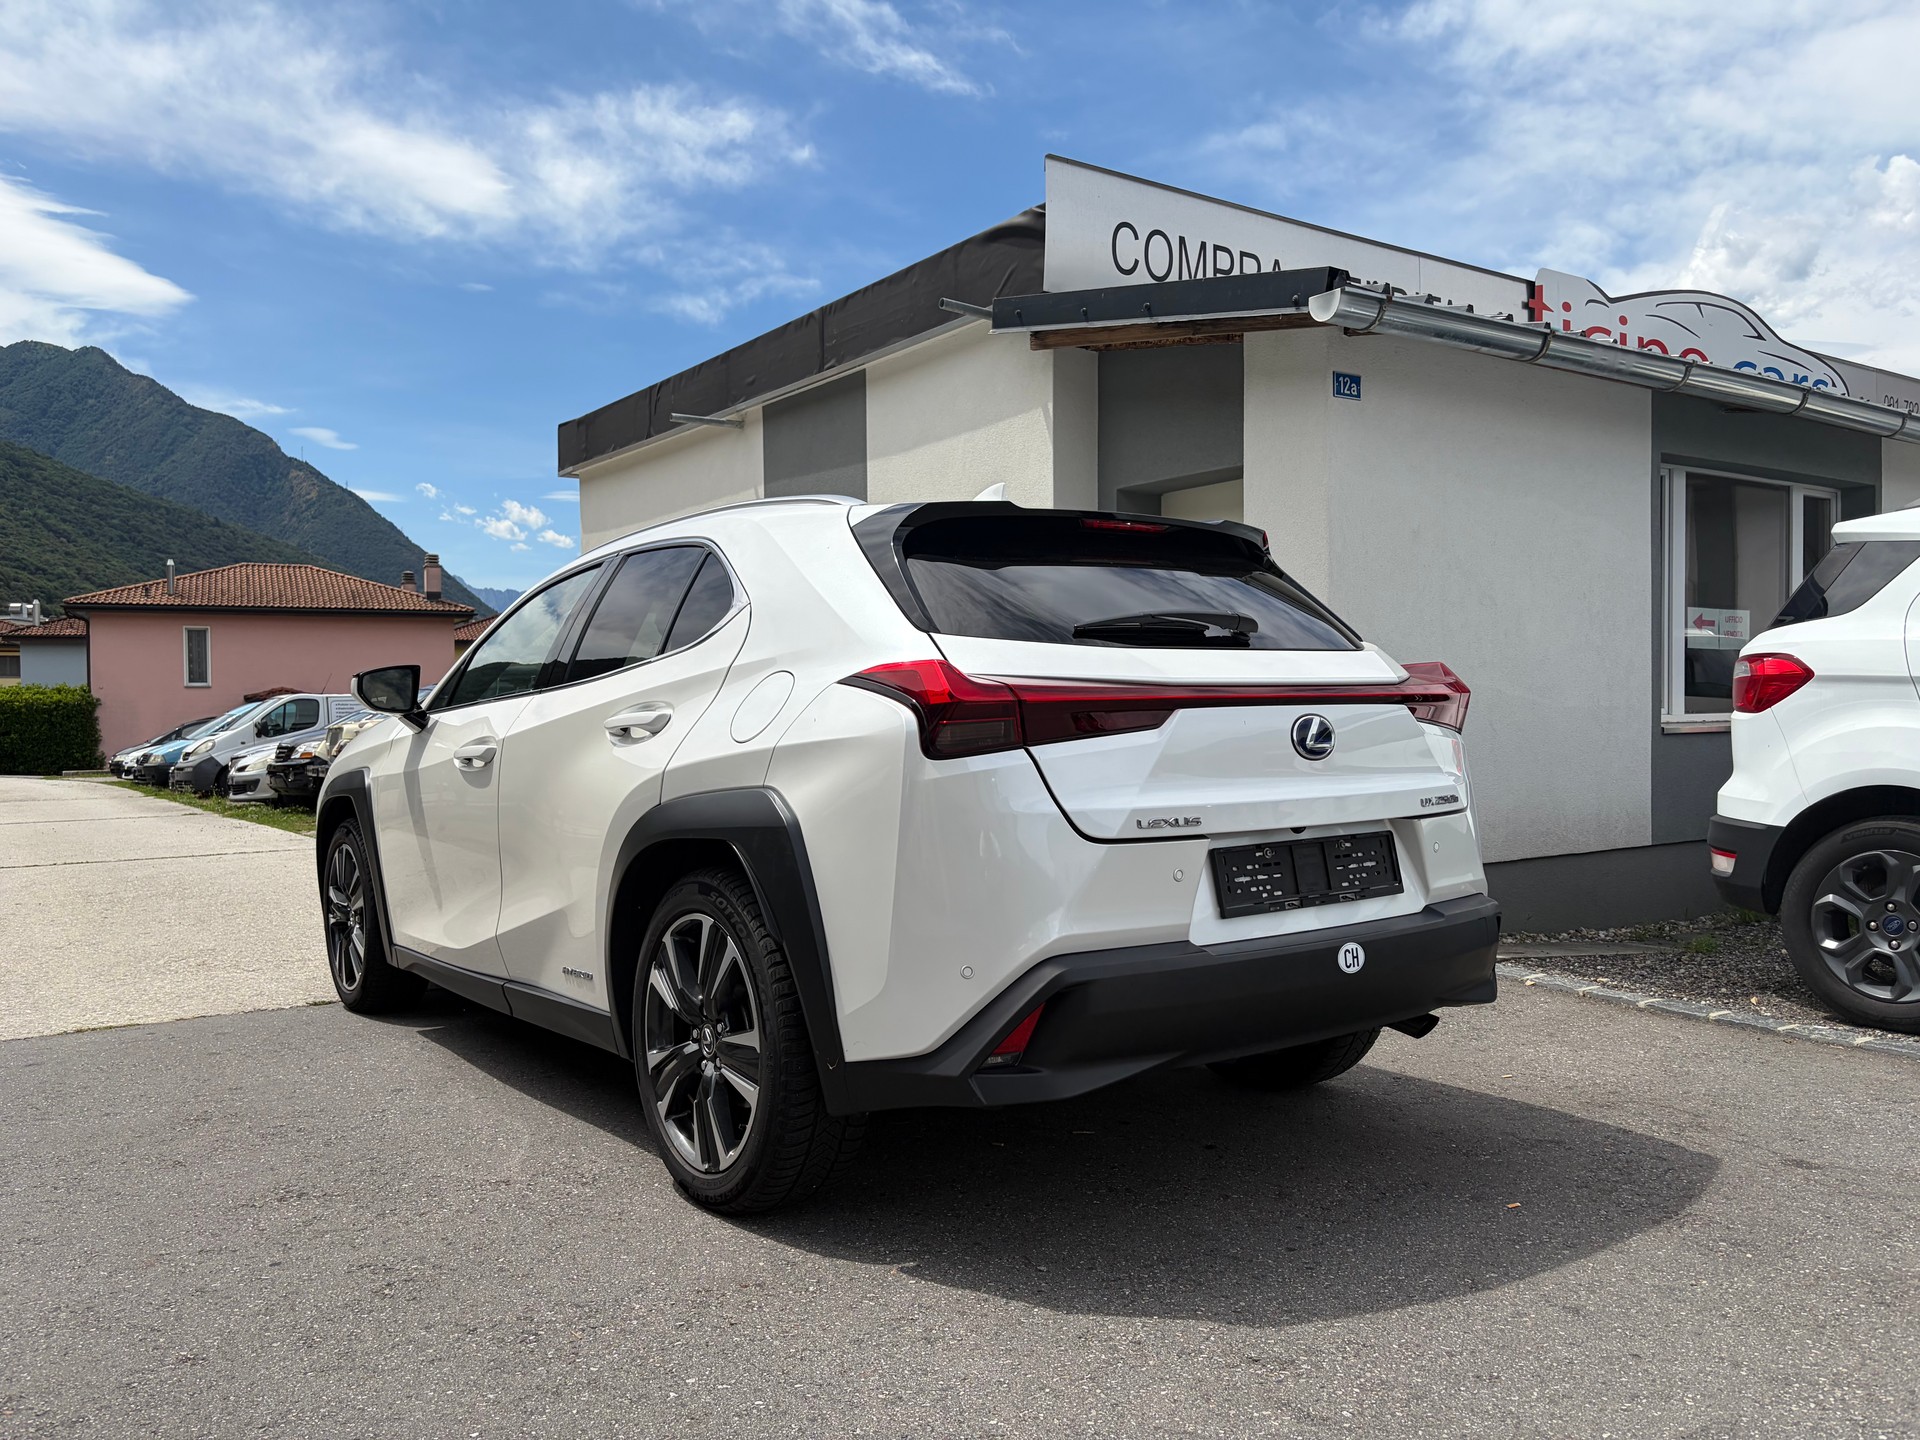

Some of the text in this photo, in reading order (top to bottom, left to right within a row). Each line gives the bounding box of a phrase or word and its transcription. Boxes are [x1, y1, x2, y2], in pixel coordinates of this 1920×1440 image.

[1338, 376, 1358, 396] 12a
[1136, 816, 1202, 830] LEXUS
[1344, 947, 1360, 969] CH
